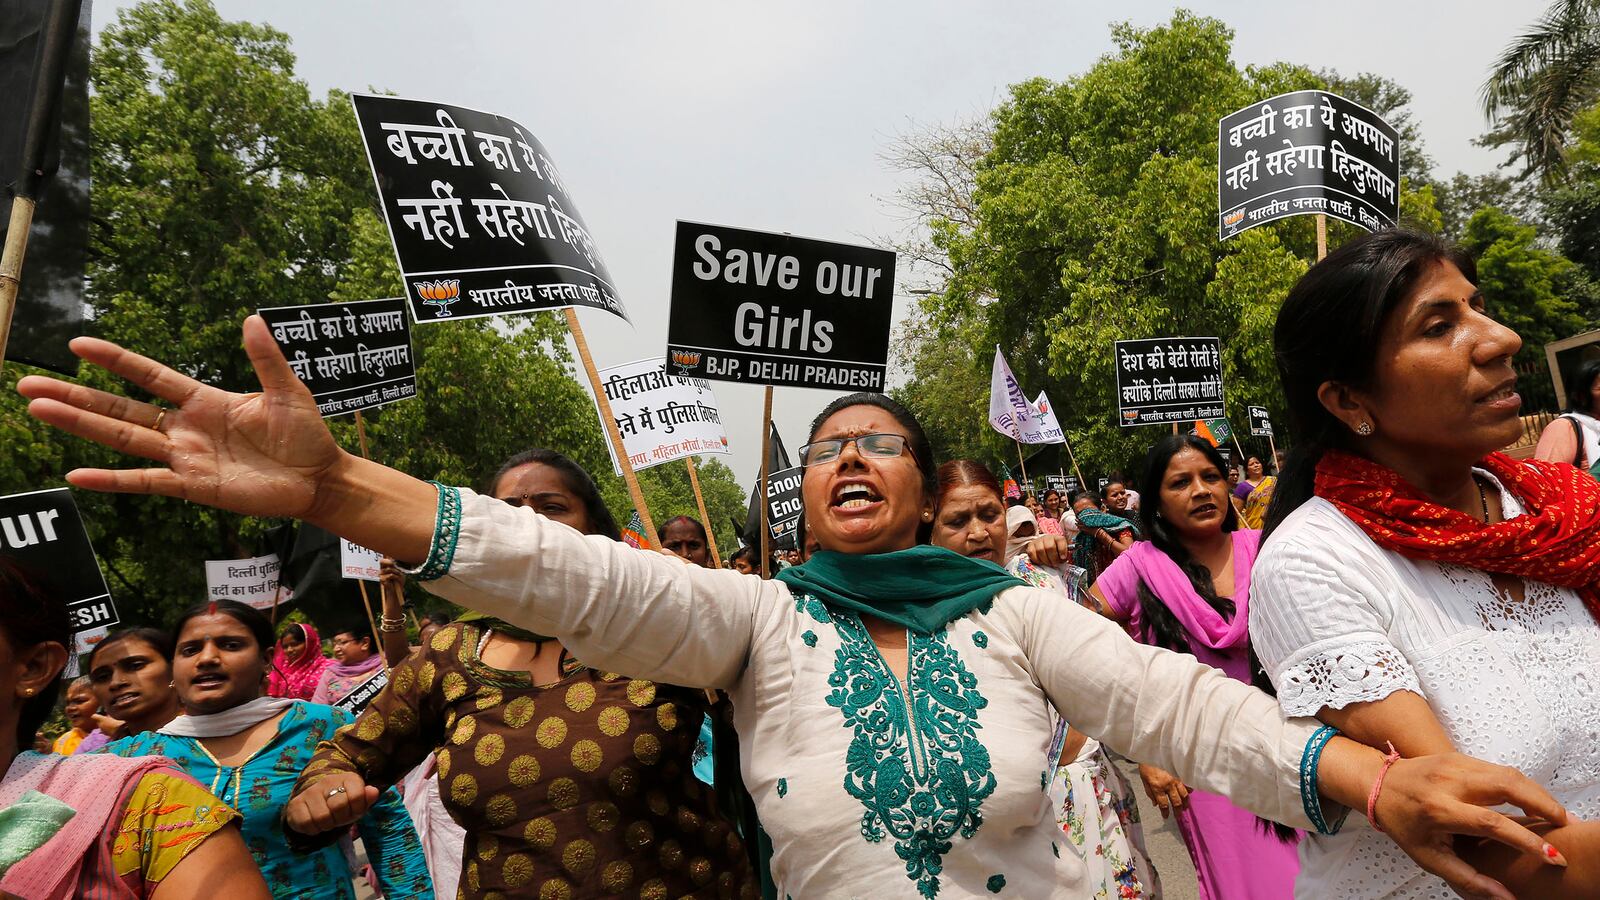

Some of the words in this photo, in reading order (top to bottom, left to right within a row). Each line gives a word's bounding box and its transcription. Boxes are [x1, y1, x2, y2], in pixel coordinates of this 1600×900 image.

[380, 109, 474, 167] बच्ची
[473, 131, 520, 172] का
[514, 127, 543, 180] ये
[1229, 104, 1278, 148] बच्ची
[1283, 104, 1314, 129] का
[1320, 96, 1336, 131] ये
[1341, 112, 1394, 163] अपमान
[1226, 149, 1261, 190] नहीं
[1265, 139, 1326, 176] सहेगा
[1330, 139, 1396, 205] हिन्दुस्तान
[397, 179, 470, 249] नहीं
[470, 182, 556, 246] सहेगा
[1248, 199, 1290, 221] भारतीय
[1291, 197, 1329, 210] जनता
[1329, 199, 1356, 221] पार्टी,
[693, 234, 800, 290] Save
[815, 261, 882, 299] our
[468, 279, 533, 308] भारतीय
[536, 283, 582, 302] जनता
[272, 310, 318, 344] बच्ची
[319, 316, 343, 339] का
[343, 307, 358, 336] ये
[360, 310, 404, 334] अपमान
[734, 302, 834, 353] Girls
[288, 350, 313, 380] हीं
[314, 347, 357, 380] सहेगा
[358, 343, 410, 377] हिन्दुस्तान
[706, 356, 742, 379] BJP,
[749, 360, 799, 382] DELHI
[804, 365, 881, 388] PRADESH
[1120, 348, 1144, 372] देश
[1146, 345, 1165, 369] की
[1168, 344, 1188, 368] बेटी
[1190, 344, 1211, 367] रोती
[1211, 344, 1219, 370] है
[344, 397, 364, 408] जनता
[382, 385, 400, 401] दिल्ली
[400, 383, 414, 397] प्रदेश
[1122, 379, 1152, 403] क्योंकि
[1153, 376, 1178, 401] दिल्ली
[1178, 382, 1201, 399] सरकार
[1200, 374, 1217, 398] सोती
[638, 407, 655, 430] में
[656, 401, 699, 434] पुलिस
[1140, 410, 1164, 421] भारतीय
[1164, 411, 1182, 420] जनता
[1198, 406, 1212, 417] दिल्ली
[1211, 405, 1223, 416] प्रदेश
[652, 444, 681, 460] महिला
[0, 508, 59, 549] ur
[228, 565, 257, 578] दिल्ली
[231, 586, 245, 595] का
[350, 688, 372, 705] Cases
[366, 684, 378, 693] in
